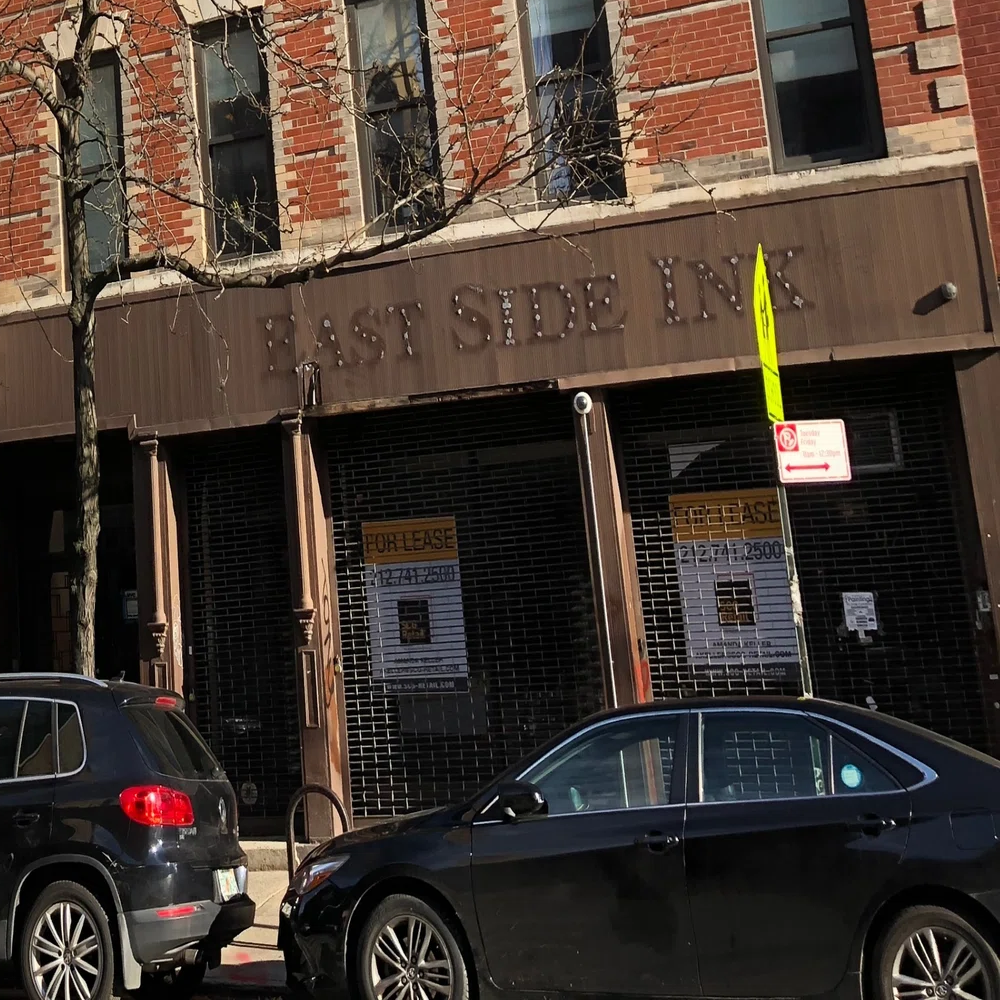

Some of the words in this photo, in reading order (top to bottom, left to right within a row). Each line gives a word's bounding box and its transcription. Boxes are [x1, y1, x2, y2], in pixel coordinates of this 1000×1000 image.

[256, 301, 424, 376] EAST
[449, 275, 628, 352] SIDE
[650, 246, 816, 327] INK
[365, 532, 397, 553] FOR
[402, 528, 455, 551] LEASE
